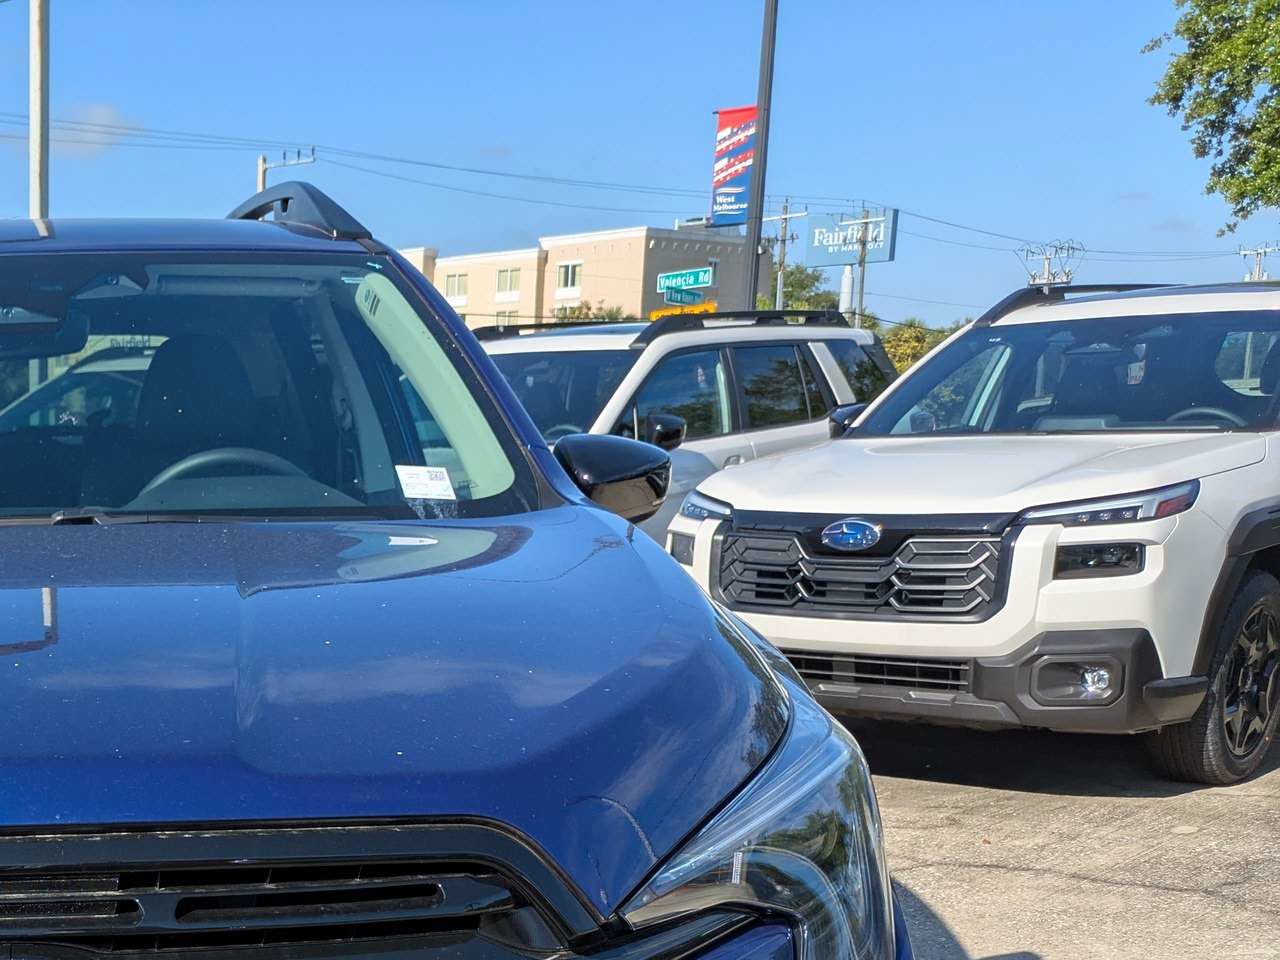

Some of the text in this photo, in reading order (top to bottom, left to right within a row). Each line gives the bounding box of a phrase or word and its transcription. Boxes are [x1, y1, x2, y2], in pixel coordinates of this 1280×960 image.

[716, 195, 736, 204] West
[812, 223, 885, 247] Fairfild
[840, 242, 884, 253] MAROTT
[660, 270, 710, 289] Valencia Rd
